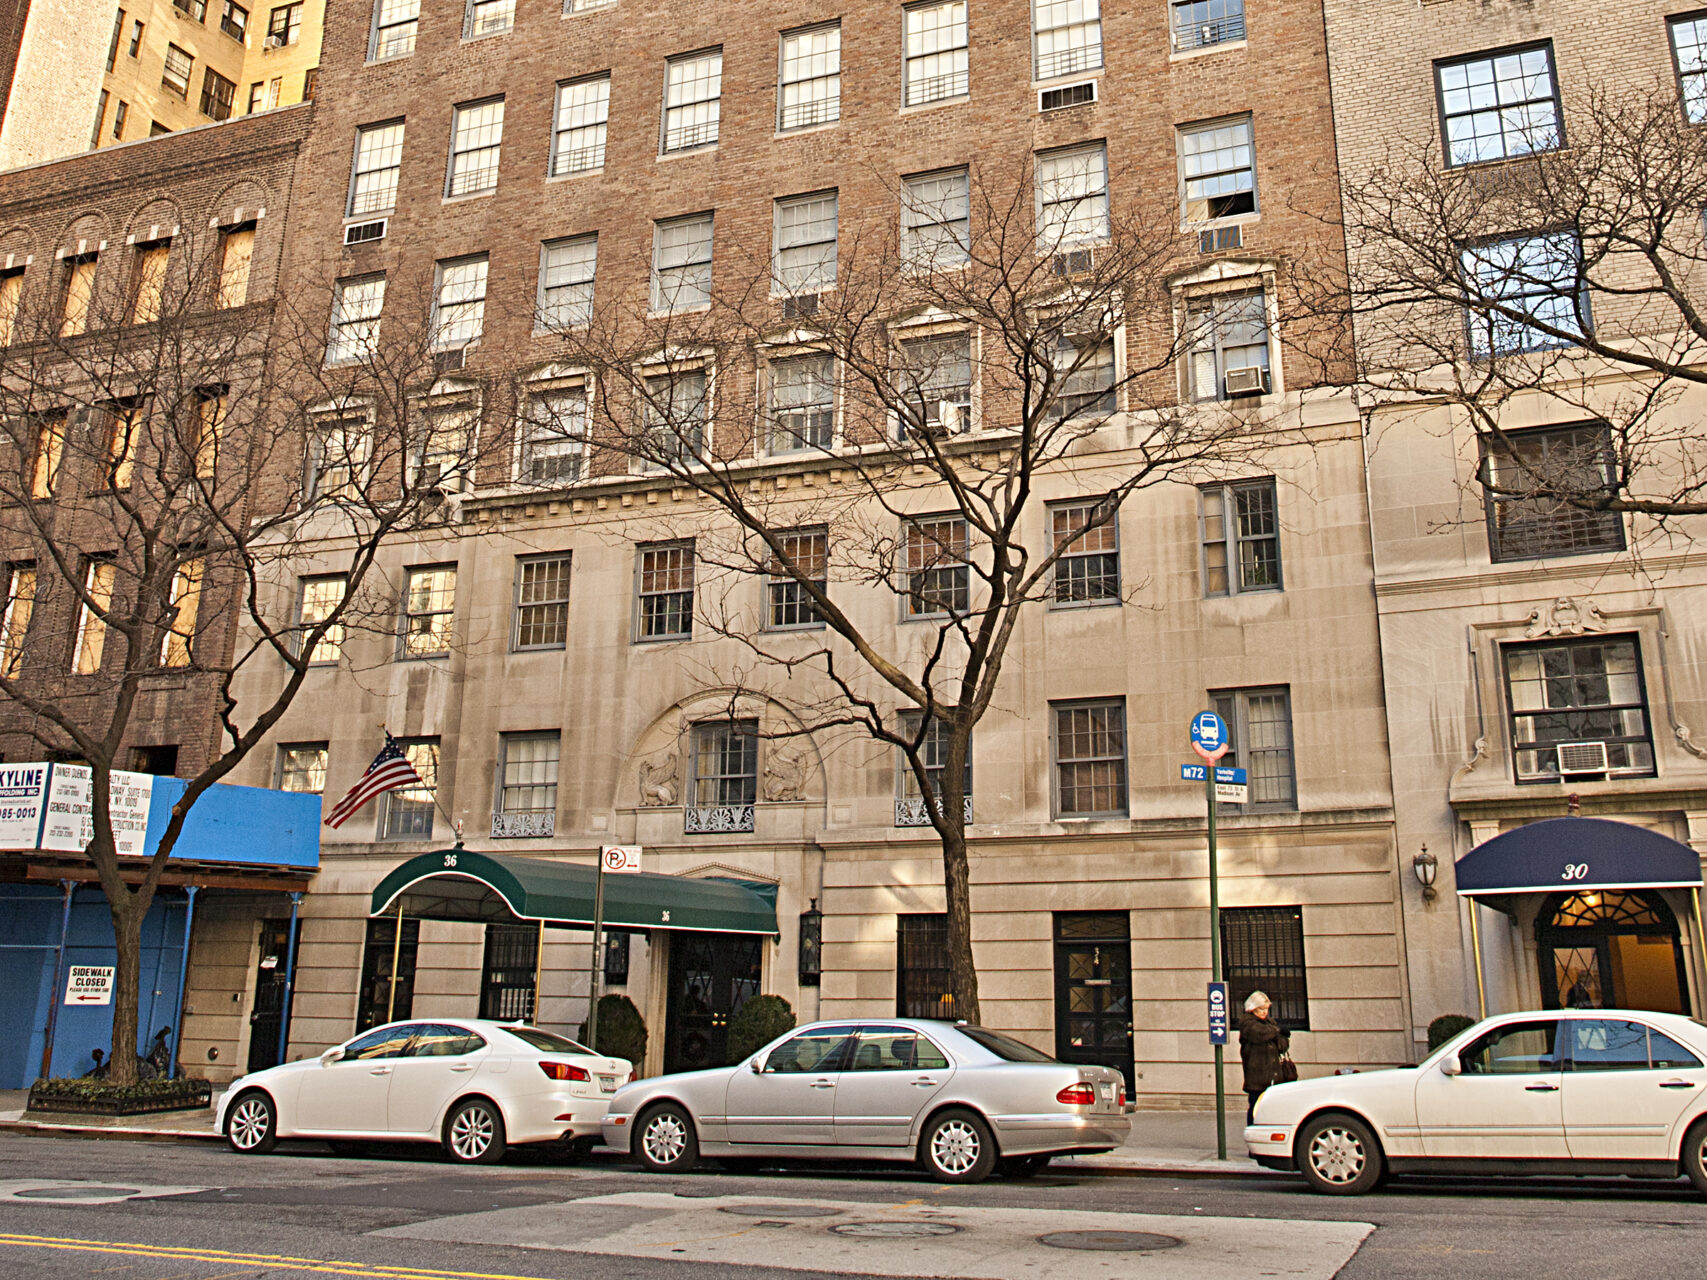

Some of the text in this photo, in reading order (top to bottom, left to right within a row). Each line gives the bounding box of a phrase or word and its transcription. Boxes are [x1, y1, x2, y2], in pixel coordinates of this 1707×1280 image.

[0, 769, 42, 787] KYLINE
[1183, 767, 1204, 779] M72
[128, 787, 141, 798] SUITE
[0, 807, 37, 819] 85-0013
[50, 802, 92, 815] GENERAL CONTRA
[443, 854, 457, 867] 36
[1561, 863, 1589, 880] 30
[662, 910, 670, 922] 36
[72, 968, 112, 976] SIDEWALK
[76, 978, 106, 986] CLOSED
